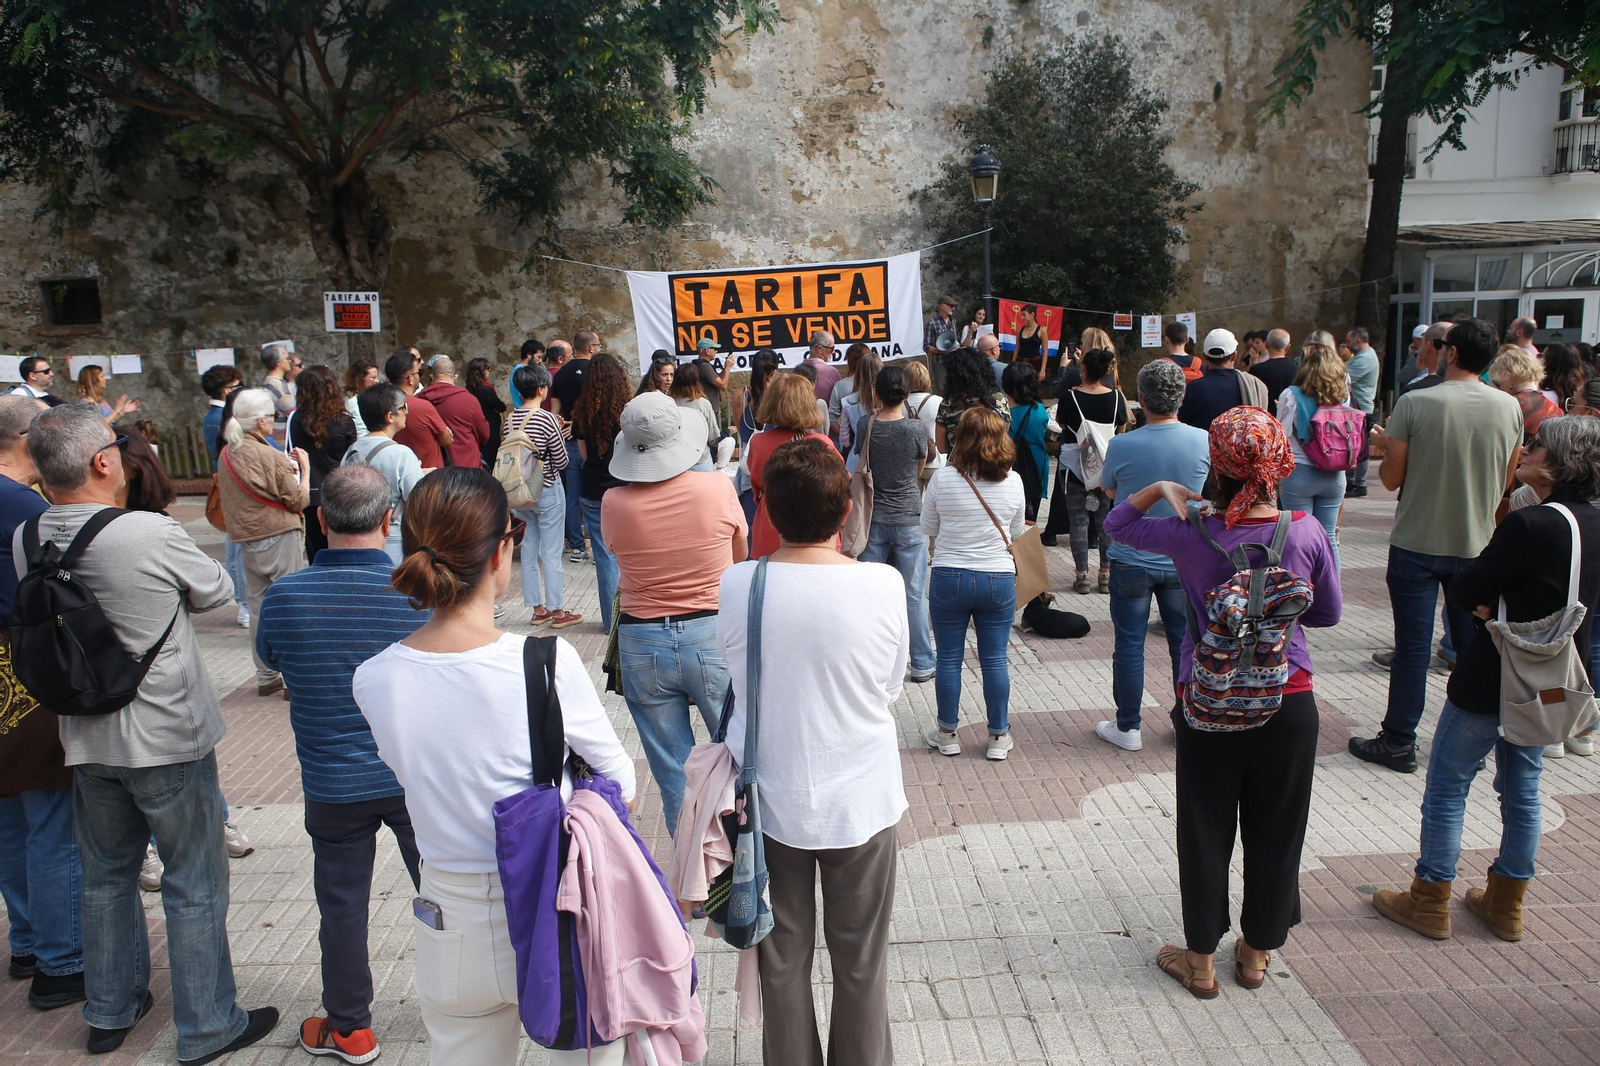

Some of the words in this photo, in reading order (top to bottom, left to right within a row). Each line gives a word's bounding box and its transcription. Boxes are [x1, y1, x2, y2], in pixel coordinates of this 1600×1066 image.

[684, 272, 871, 316] TARIFA
[677, 323, 718, 352] NO
[732, 319, 772, 348] SE
[785, 312, 887, 343] VENDE
